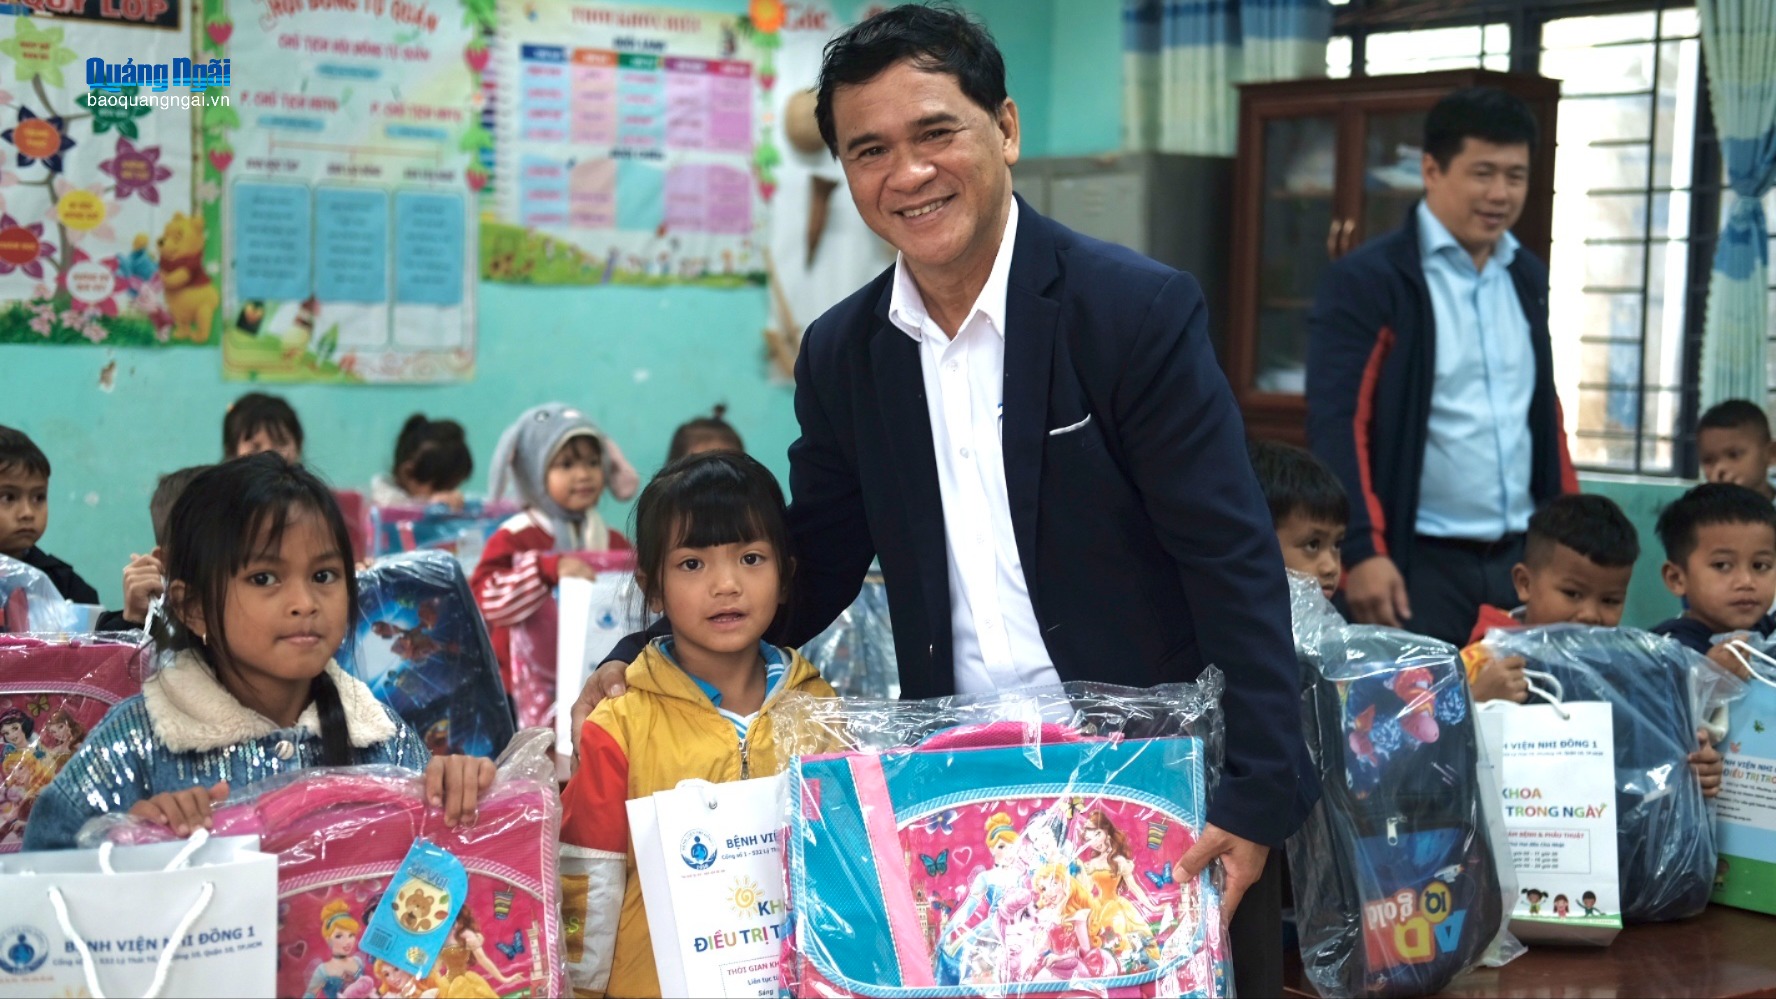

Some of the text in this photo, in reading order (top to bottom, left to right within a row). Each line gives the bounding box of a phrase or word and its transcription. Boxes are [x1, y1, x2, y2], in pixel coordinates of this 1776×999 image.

[1593, 740, 1597, 749] 1
[1505, 804, 1605, 819] TRONG NGÀY
[726, 834, 758, 850] BỆNH
[1364, 892, 1414, 931] gold
[65, 940, 111, 953] BNH
[116, 936, 157, 953] VIỆN
[198, 927, 243, 945] ĐỒNG
[247, 925, 255, 938] 1
[694, 924, 780, 953] ĐIỀU TRỊ T
[727, 966, 747, 976] THỜI
[748, 963, 768, 973] GIAN
[758, 989, 774, 997] Sáng
